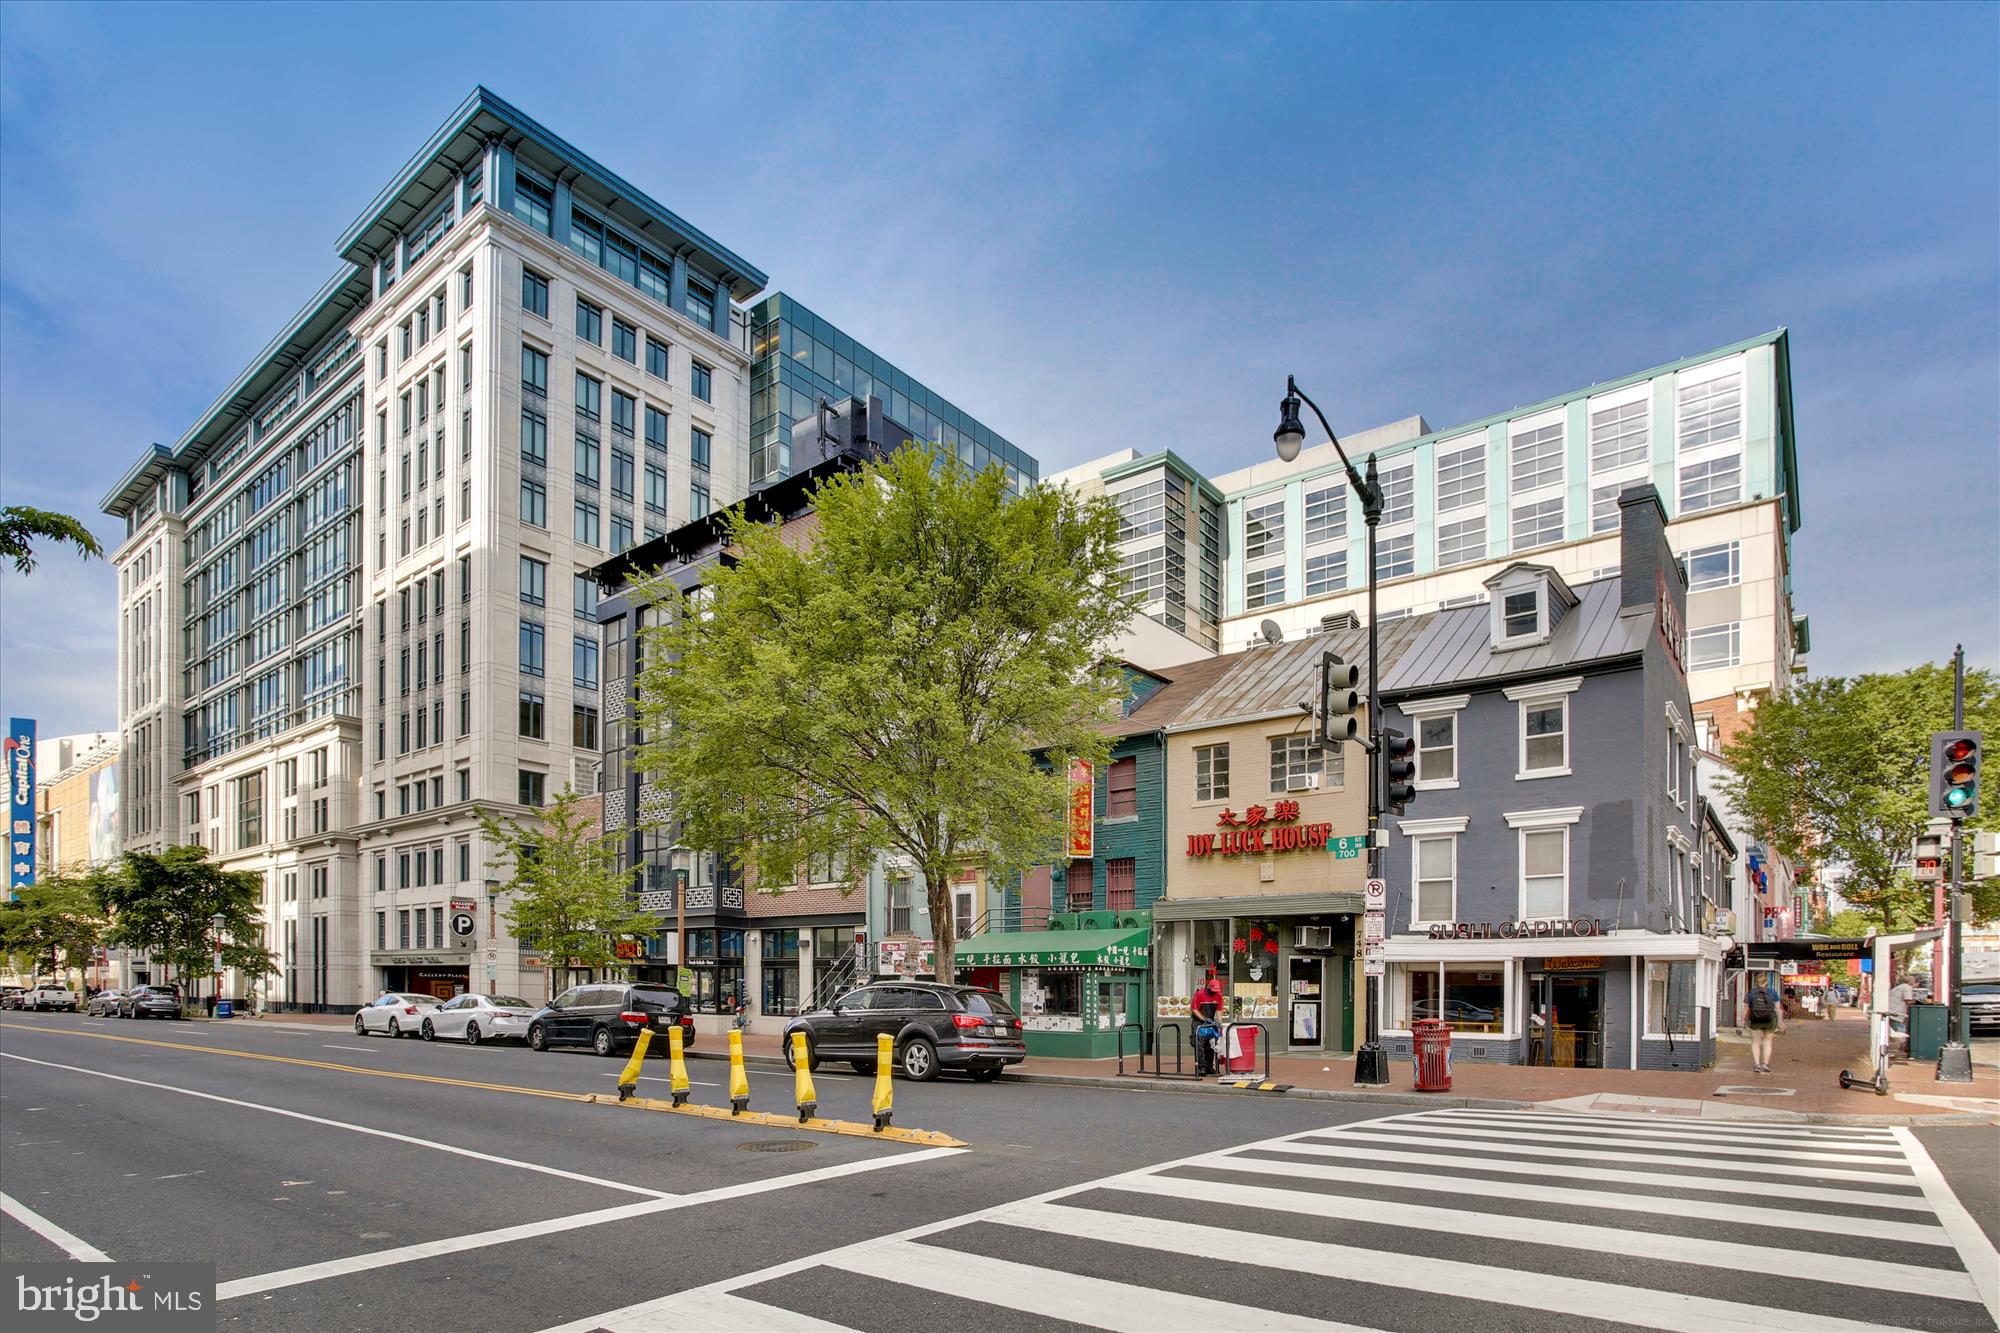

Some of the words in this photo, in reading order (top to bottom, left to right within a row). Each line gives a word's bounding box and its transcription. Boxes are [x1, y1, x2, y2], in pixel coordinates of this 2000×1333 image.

[1216, 800, 1300, 827] 大家樂
[1186, 834, 1216, 857] JOY
[1220, 829, 1267, 855] LUCK
[1271, 823, 1333, 850] HOUSE
[1338, 838, 1347, 849] 6
[1339, 850, 1355, 858] 700
[458, 916, 471, 933] P
[1429, 922, 1493, 941] SUSHI
[1499, 919, 1607, 940] CAPITOL
[1812, 943, 1830, 951] WOK
